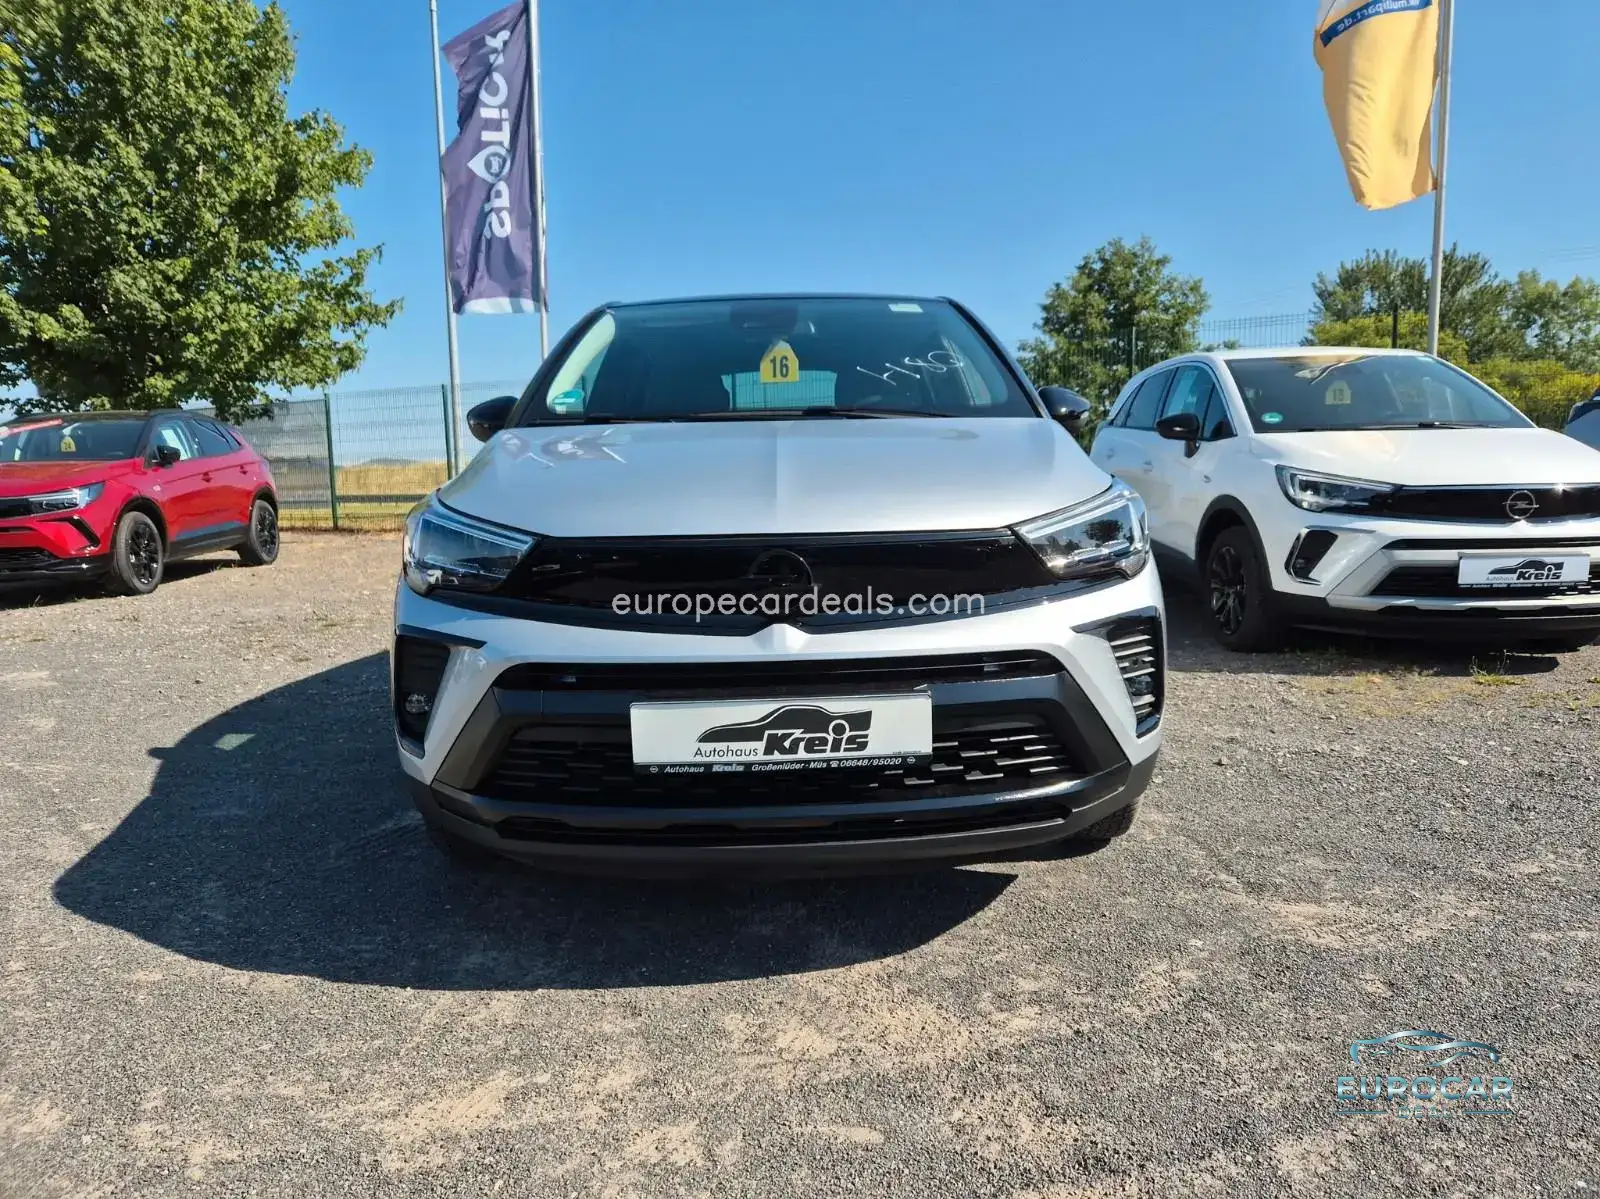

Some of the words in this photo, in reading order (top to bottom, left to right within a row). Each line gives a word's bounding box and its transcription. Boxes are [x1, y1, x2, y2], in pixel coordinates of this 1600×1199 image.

[770, 355, 789, 379] 16
[1515, 565, 1562, 581] Kreis
[693, 744, 759, 758] Autohaus
[762, 720, 870, 756] Kreis
[664, 765, 705, 773] Autohaus
[840, 757, 902, 768] 06648/95020
